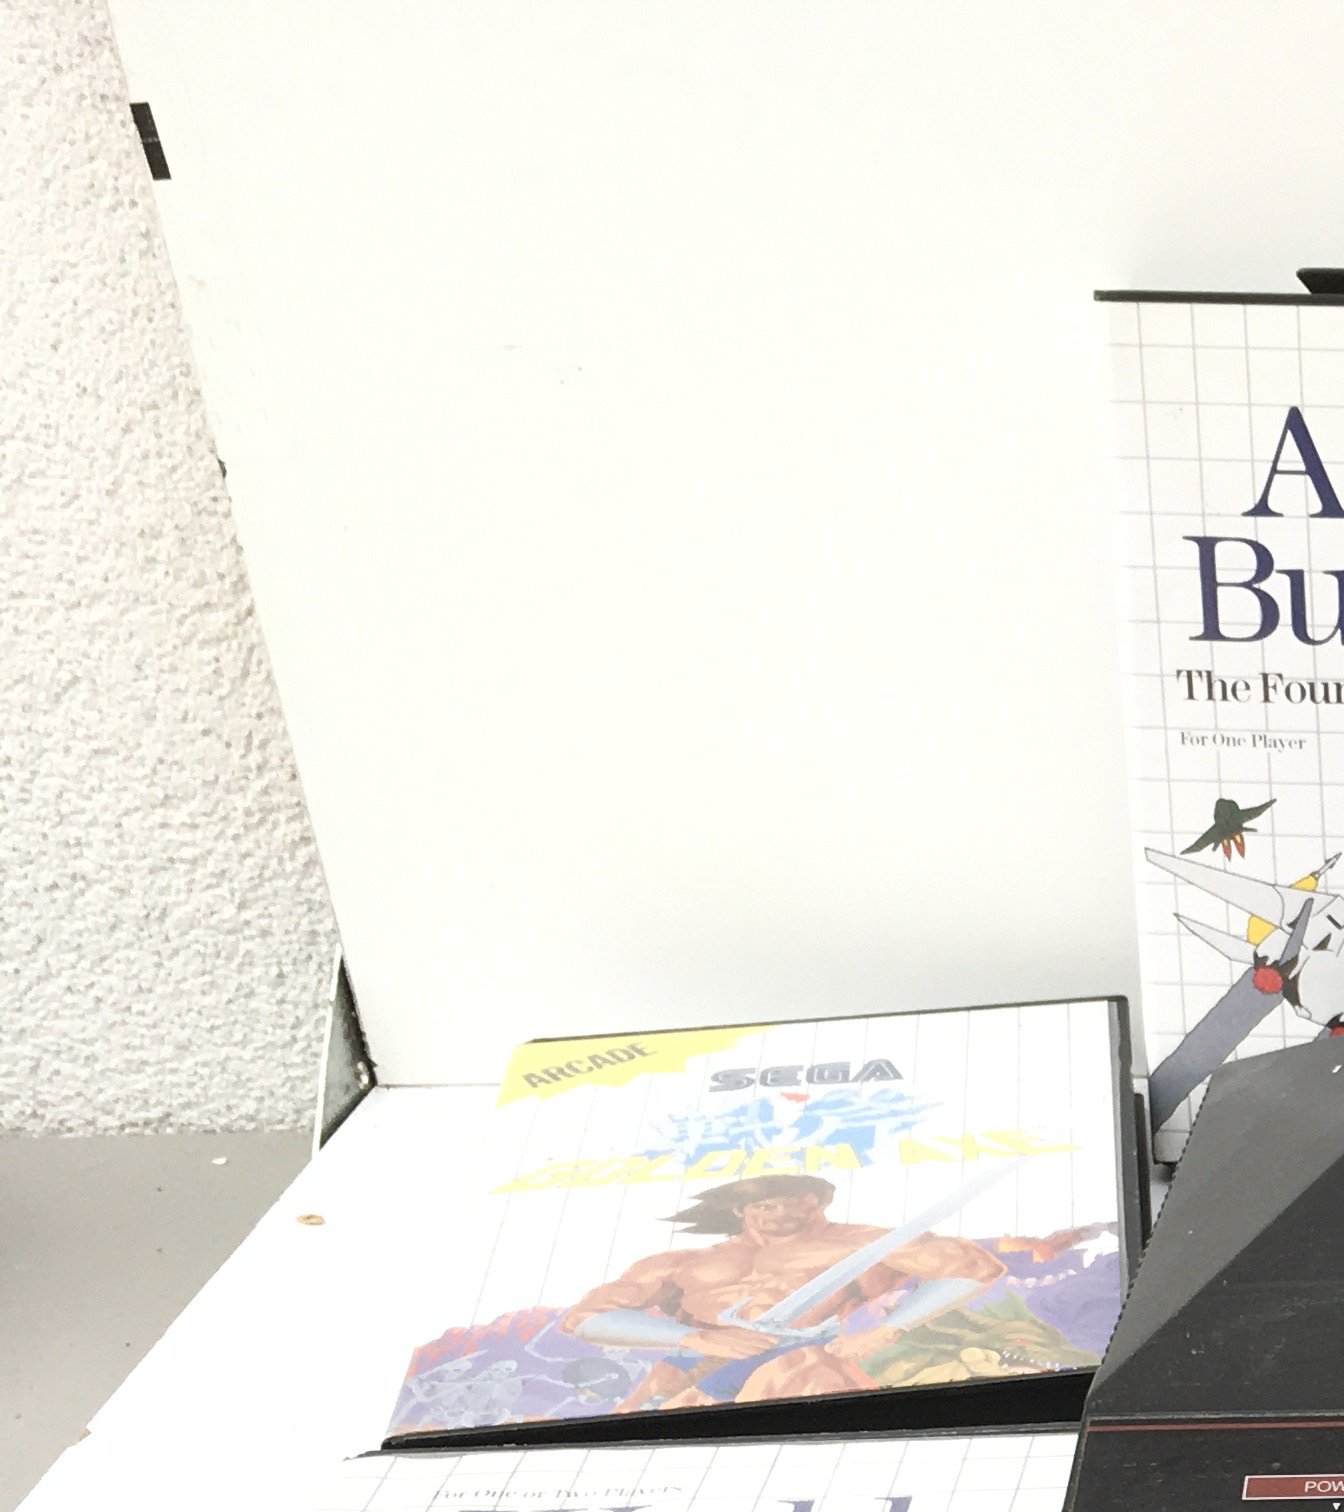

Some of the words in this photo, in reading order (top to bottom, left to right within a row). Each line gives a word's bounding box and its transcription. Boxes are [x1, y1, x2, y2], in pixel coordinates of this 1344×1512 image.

[1177, 670, 1251, 704] The
[1179, 732, 1207, 746] For
[1211, 733, 1246, 748] One
[1251, 733, 1307, 753] Player
[522, 1041, 658, 1089] ARCADE
[709, 1058, 904, 1092] SEGA
[489, 1143, 865, 1195] GOLDEN
[899, 1129, 1083, 1165] AXE
